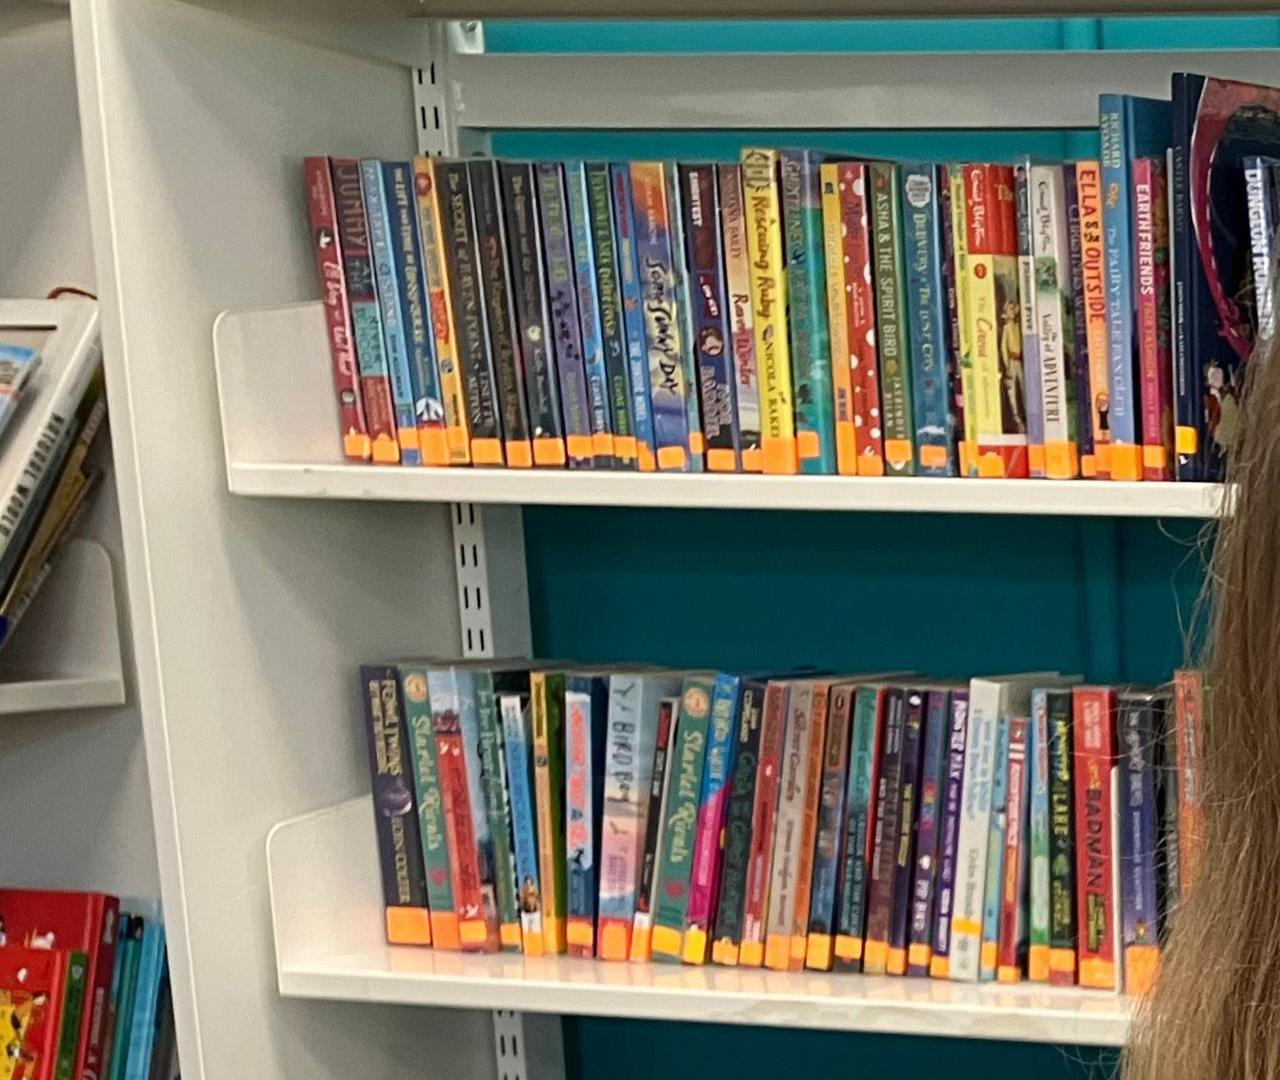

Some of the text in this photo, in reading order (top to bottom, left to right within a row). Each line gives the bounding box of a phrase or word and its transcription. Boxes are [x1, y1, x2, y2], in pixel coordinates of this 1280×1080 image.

[451, 193, 468, 242] SECRET
[1079, 170, 1099, 217] ELLA
[750, 195, 775, 318] Rescuing Ruby
[876, 192, 897, 357] ASHA & THE SPIRIT BIRD
[1085, 247, 1105, 324] OUTSIDE
[1084, 788, 1103, 888] BADMAN
